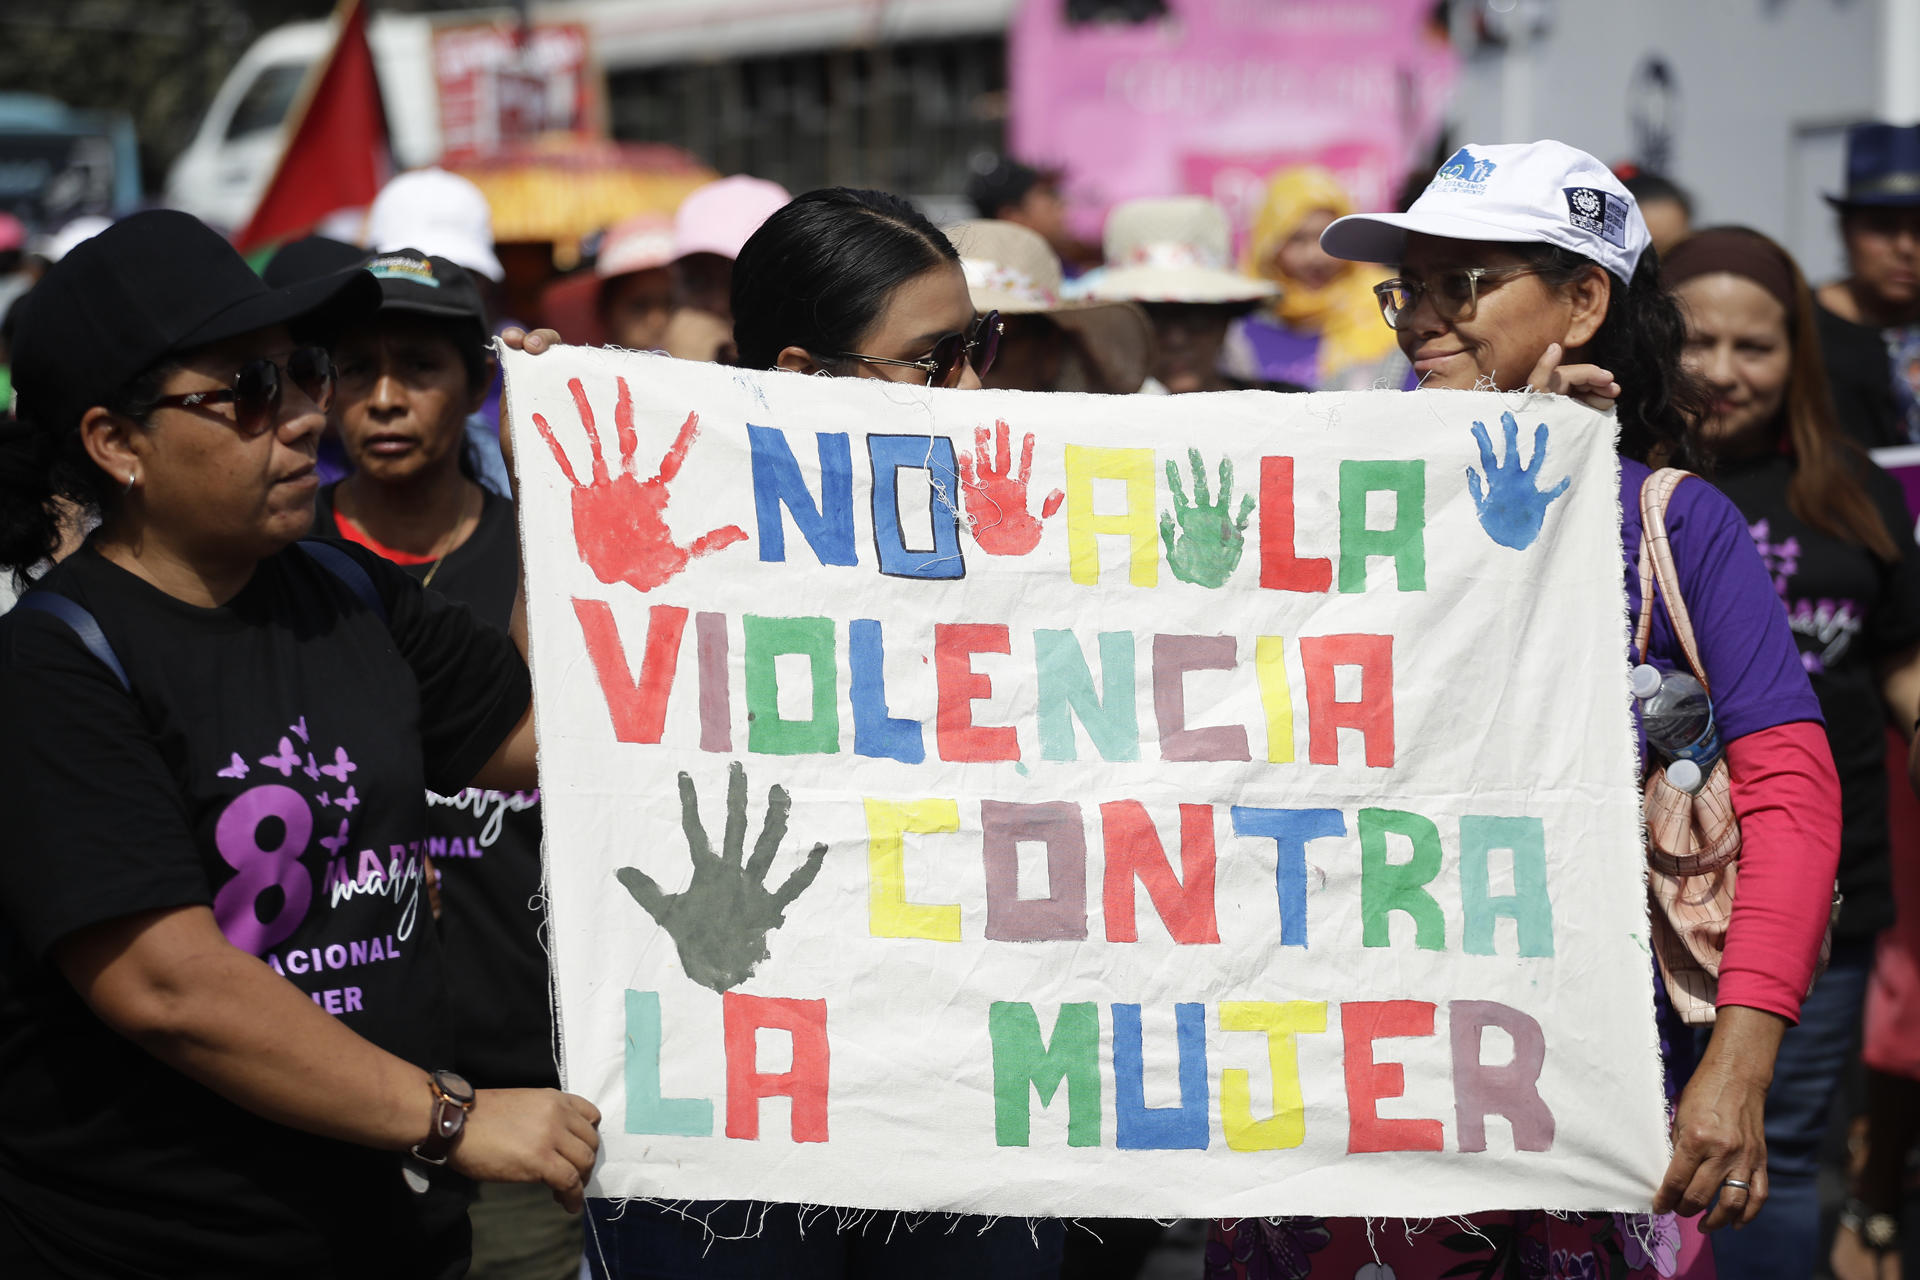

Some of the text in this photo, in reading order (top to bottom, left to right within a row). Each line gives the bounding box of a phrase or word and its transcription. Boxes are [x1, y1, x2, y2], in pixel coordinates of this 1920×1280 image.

[747, 423, 1427, 593] NO A LA
[570, 597, 1395, 768] VIOLENCIA
[213, 784, 314, 958] 8
[863, 798, 1555, 958] CONTRA
[624, 988, 1556, 1156] LA MUJER
